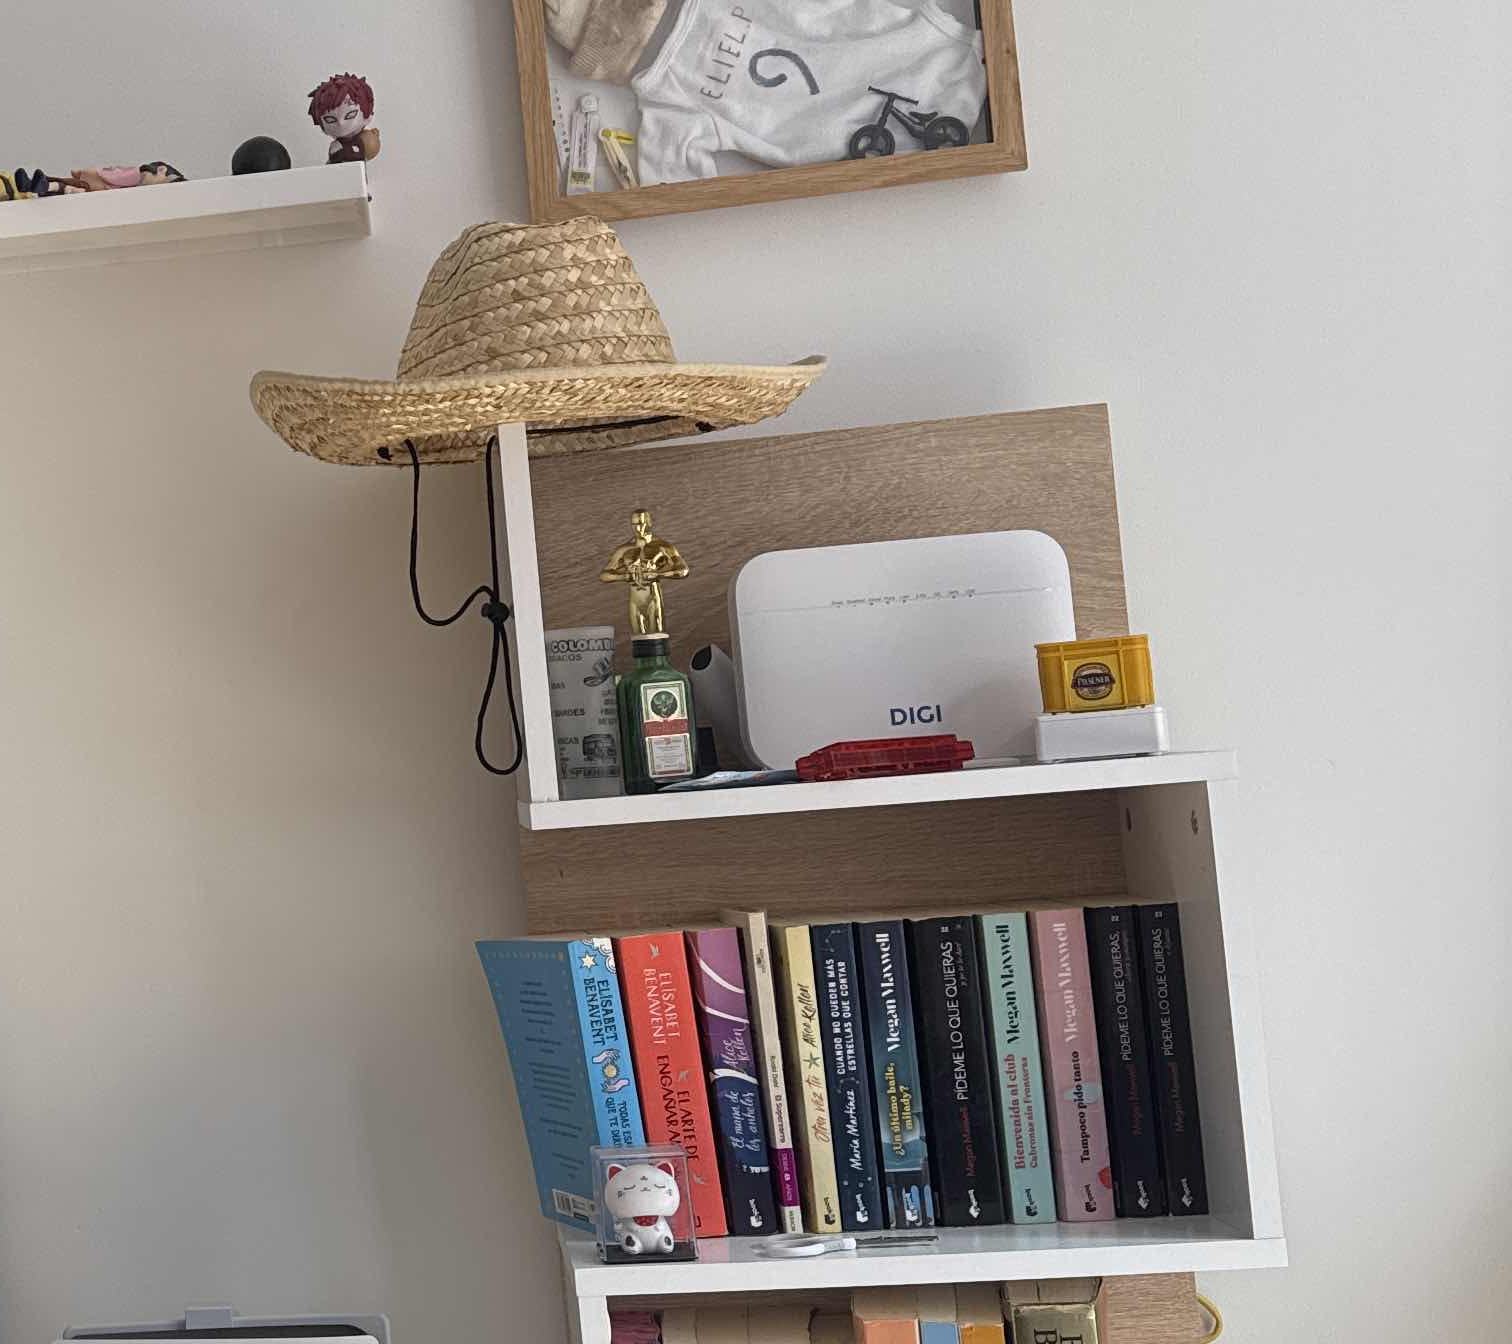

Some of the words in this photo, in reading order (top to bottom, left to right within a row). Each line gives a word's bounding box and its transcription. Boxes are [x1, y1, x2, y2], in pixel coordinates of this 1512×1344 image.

[890, 704, 942, 726] DIGI
[875, 932, 896, 998] Maxwell
[995, 924, 1014, 989] Maxwell
[1052, 922, 1072, 988] Maxwell
[1151, 928, 1166, 974] QUIERAS
[825, 958, 835, 979] MÁS
[837, 960, 850, 1000] CONTAR
[940, 941, 958, 998] QUIERAS
[796, 983, 816, 1023] Kellen
[829, 980, 840, 1022] QUEDEN
[1113, 980, 1127, 1004] QUE
[1155, 974, 1169, 999] QUE
[583, 977, 606, 1046] BENAVENT
[643, 968, 667, 1045] BENAVENT
[659, 972, 681, 1038] ELÍSABET
[842, 1001, 852, 1019] QUE
[946, 1000, 962, 1030] QUE
[1005, 990, 1021, 1044] Megan
[1062, 989, 1079, 1042] Megan
[1116, 1005, 1128, 1021] LO
[1158, 1000, 1171, 1015] LO
[801, 1022, 818, 1049] Alice
[833, 1023, 841, 1035] NO
[886, 999, 901, 1052] Megan
[949, 1031, 966, 1053] LO
[1118, 1021, 1133, 1061] PÍDEME
[1160, 1015, 1174, 1057] PÍDEME
[721, 1040, 738, 1069] Alice
[734, 1024, 749, 1062] Kellen
[836, 1036, 845, 1075] CUANDO
[844, 1021, 857, 1072] ESTRELLAS
[885, 1061, 897, 1094] baile,
[951, 1053, 969, 1102] PÍDEME
[1003, 1053, 1017, 1081] club
[1069, 1050, 1083, 1083] tanto
[605, 1097, 617, 1115] QUE
[656, 1055, 679, 1128] ENGAÑAR
[677, 1090, 690, 1104] EL
[724, 1089, 740, 1101] de
[1006, 1083, 1019, 1097] al
[1073, 1083, 1086, 1110] pido
[609, 1117, 619, 1128] TE
[618, 1101, 630, 1129] TODAS
[731, 1109, 745, 1135] mapa
[740, 1091, 758, 1134] anhelos
[843, 1087, 859, 1133] Martínez
[889, 1095, 902, 1133] último
[899, 1084, 913, 1130] milady?
[612, 1129, 621, 1148] DIR
[680, 1108, 696, 1142] ARTE
[811, 1116, 831, 1143] Otra
[1010, 1099, 1026, 1169] Bienvenida
[1077, 1111, 1091, 1164] Tampoco
[685, 1145, 700, 1161] DE
[730, 1135, 745, 1149] El
[745, 1136, 761, 1152] los
[848, 1134, 863, 1171] María
[892, 1134, 905, 1157] ¿Un
